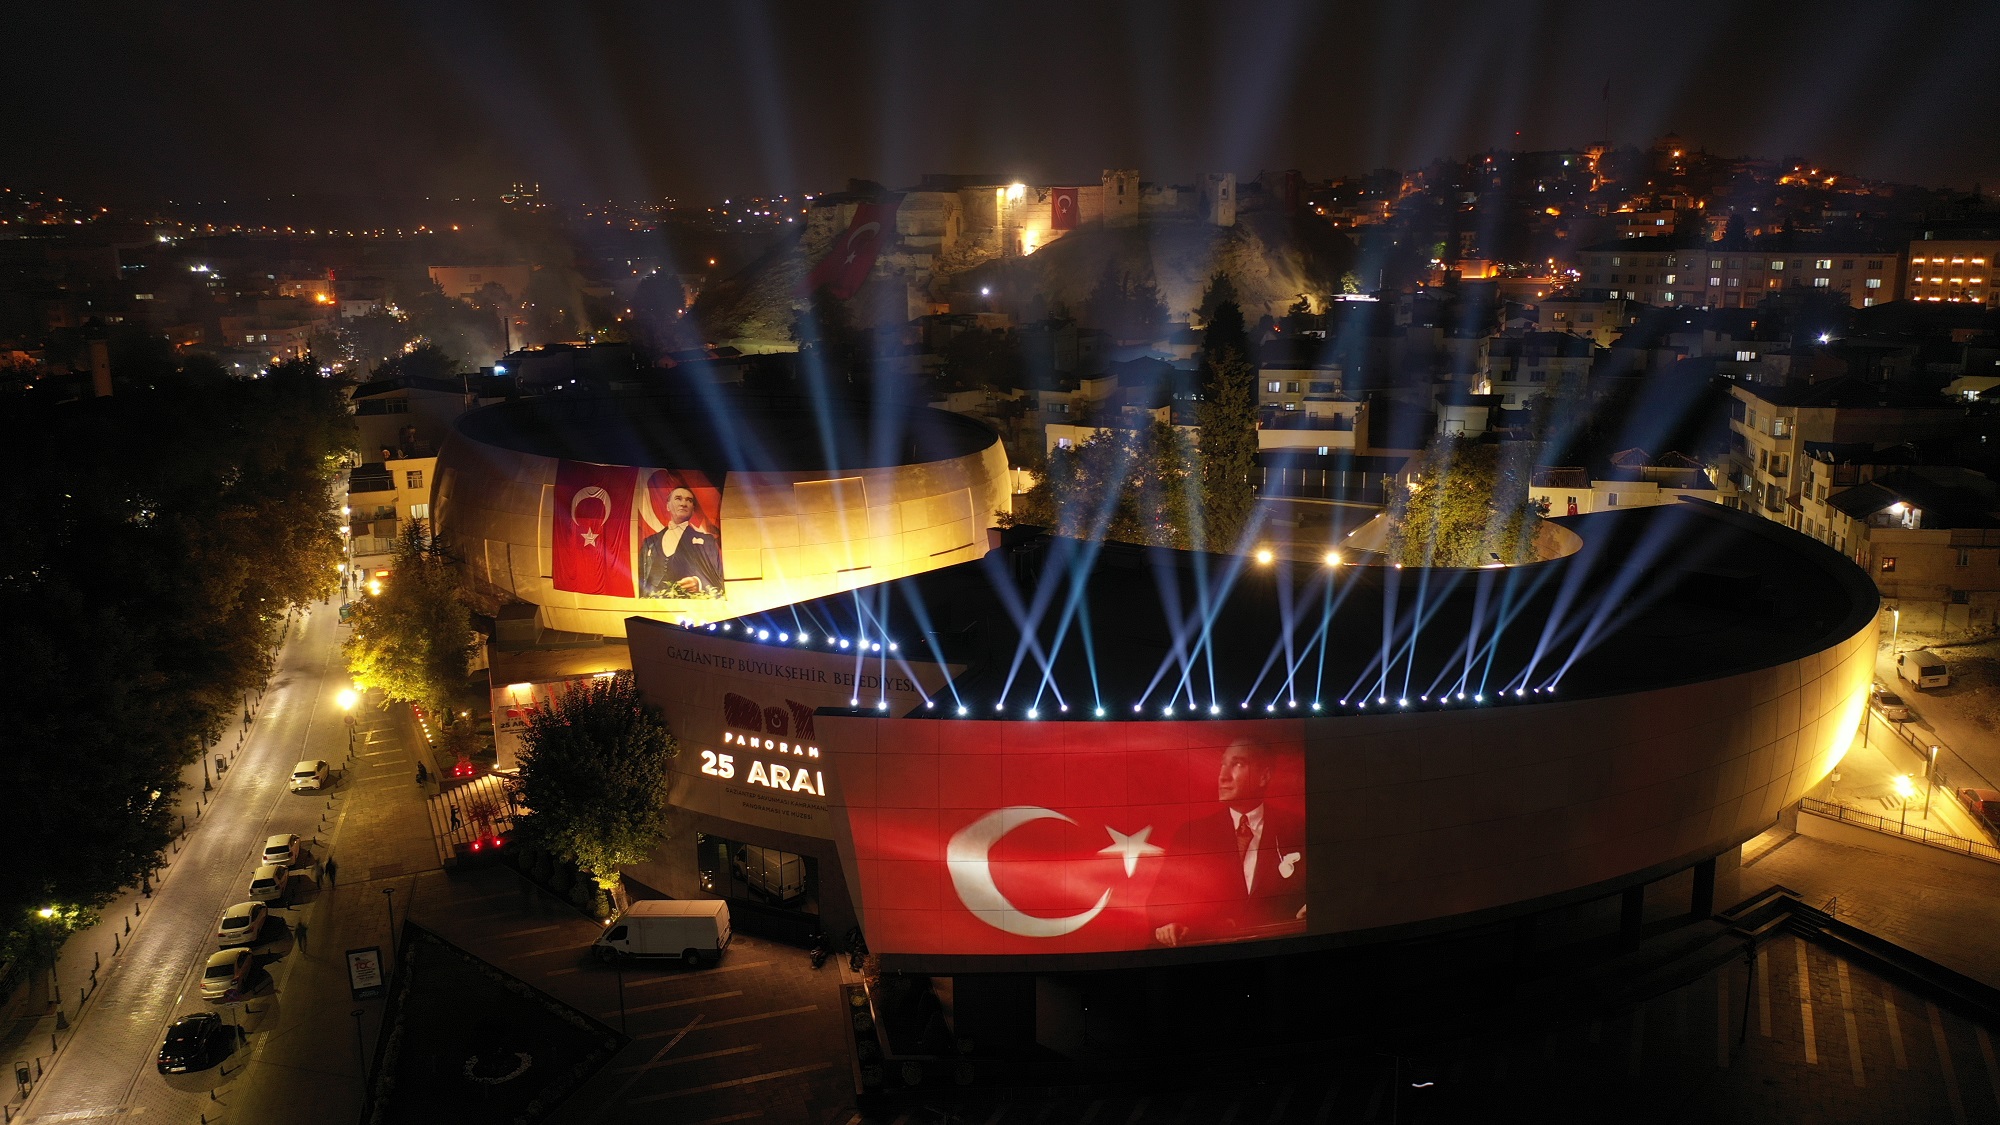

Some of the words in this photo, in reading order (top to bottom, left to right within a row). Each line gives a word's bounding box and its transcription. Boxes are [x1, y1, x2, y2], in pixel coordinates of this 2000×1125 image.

[667, 646, 735, 669] GAZİANTEP
[738, 658, 827, 683] BÜYÜKŞEHİR
[701, 750, 735, 779] 25
